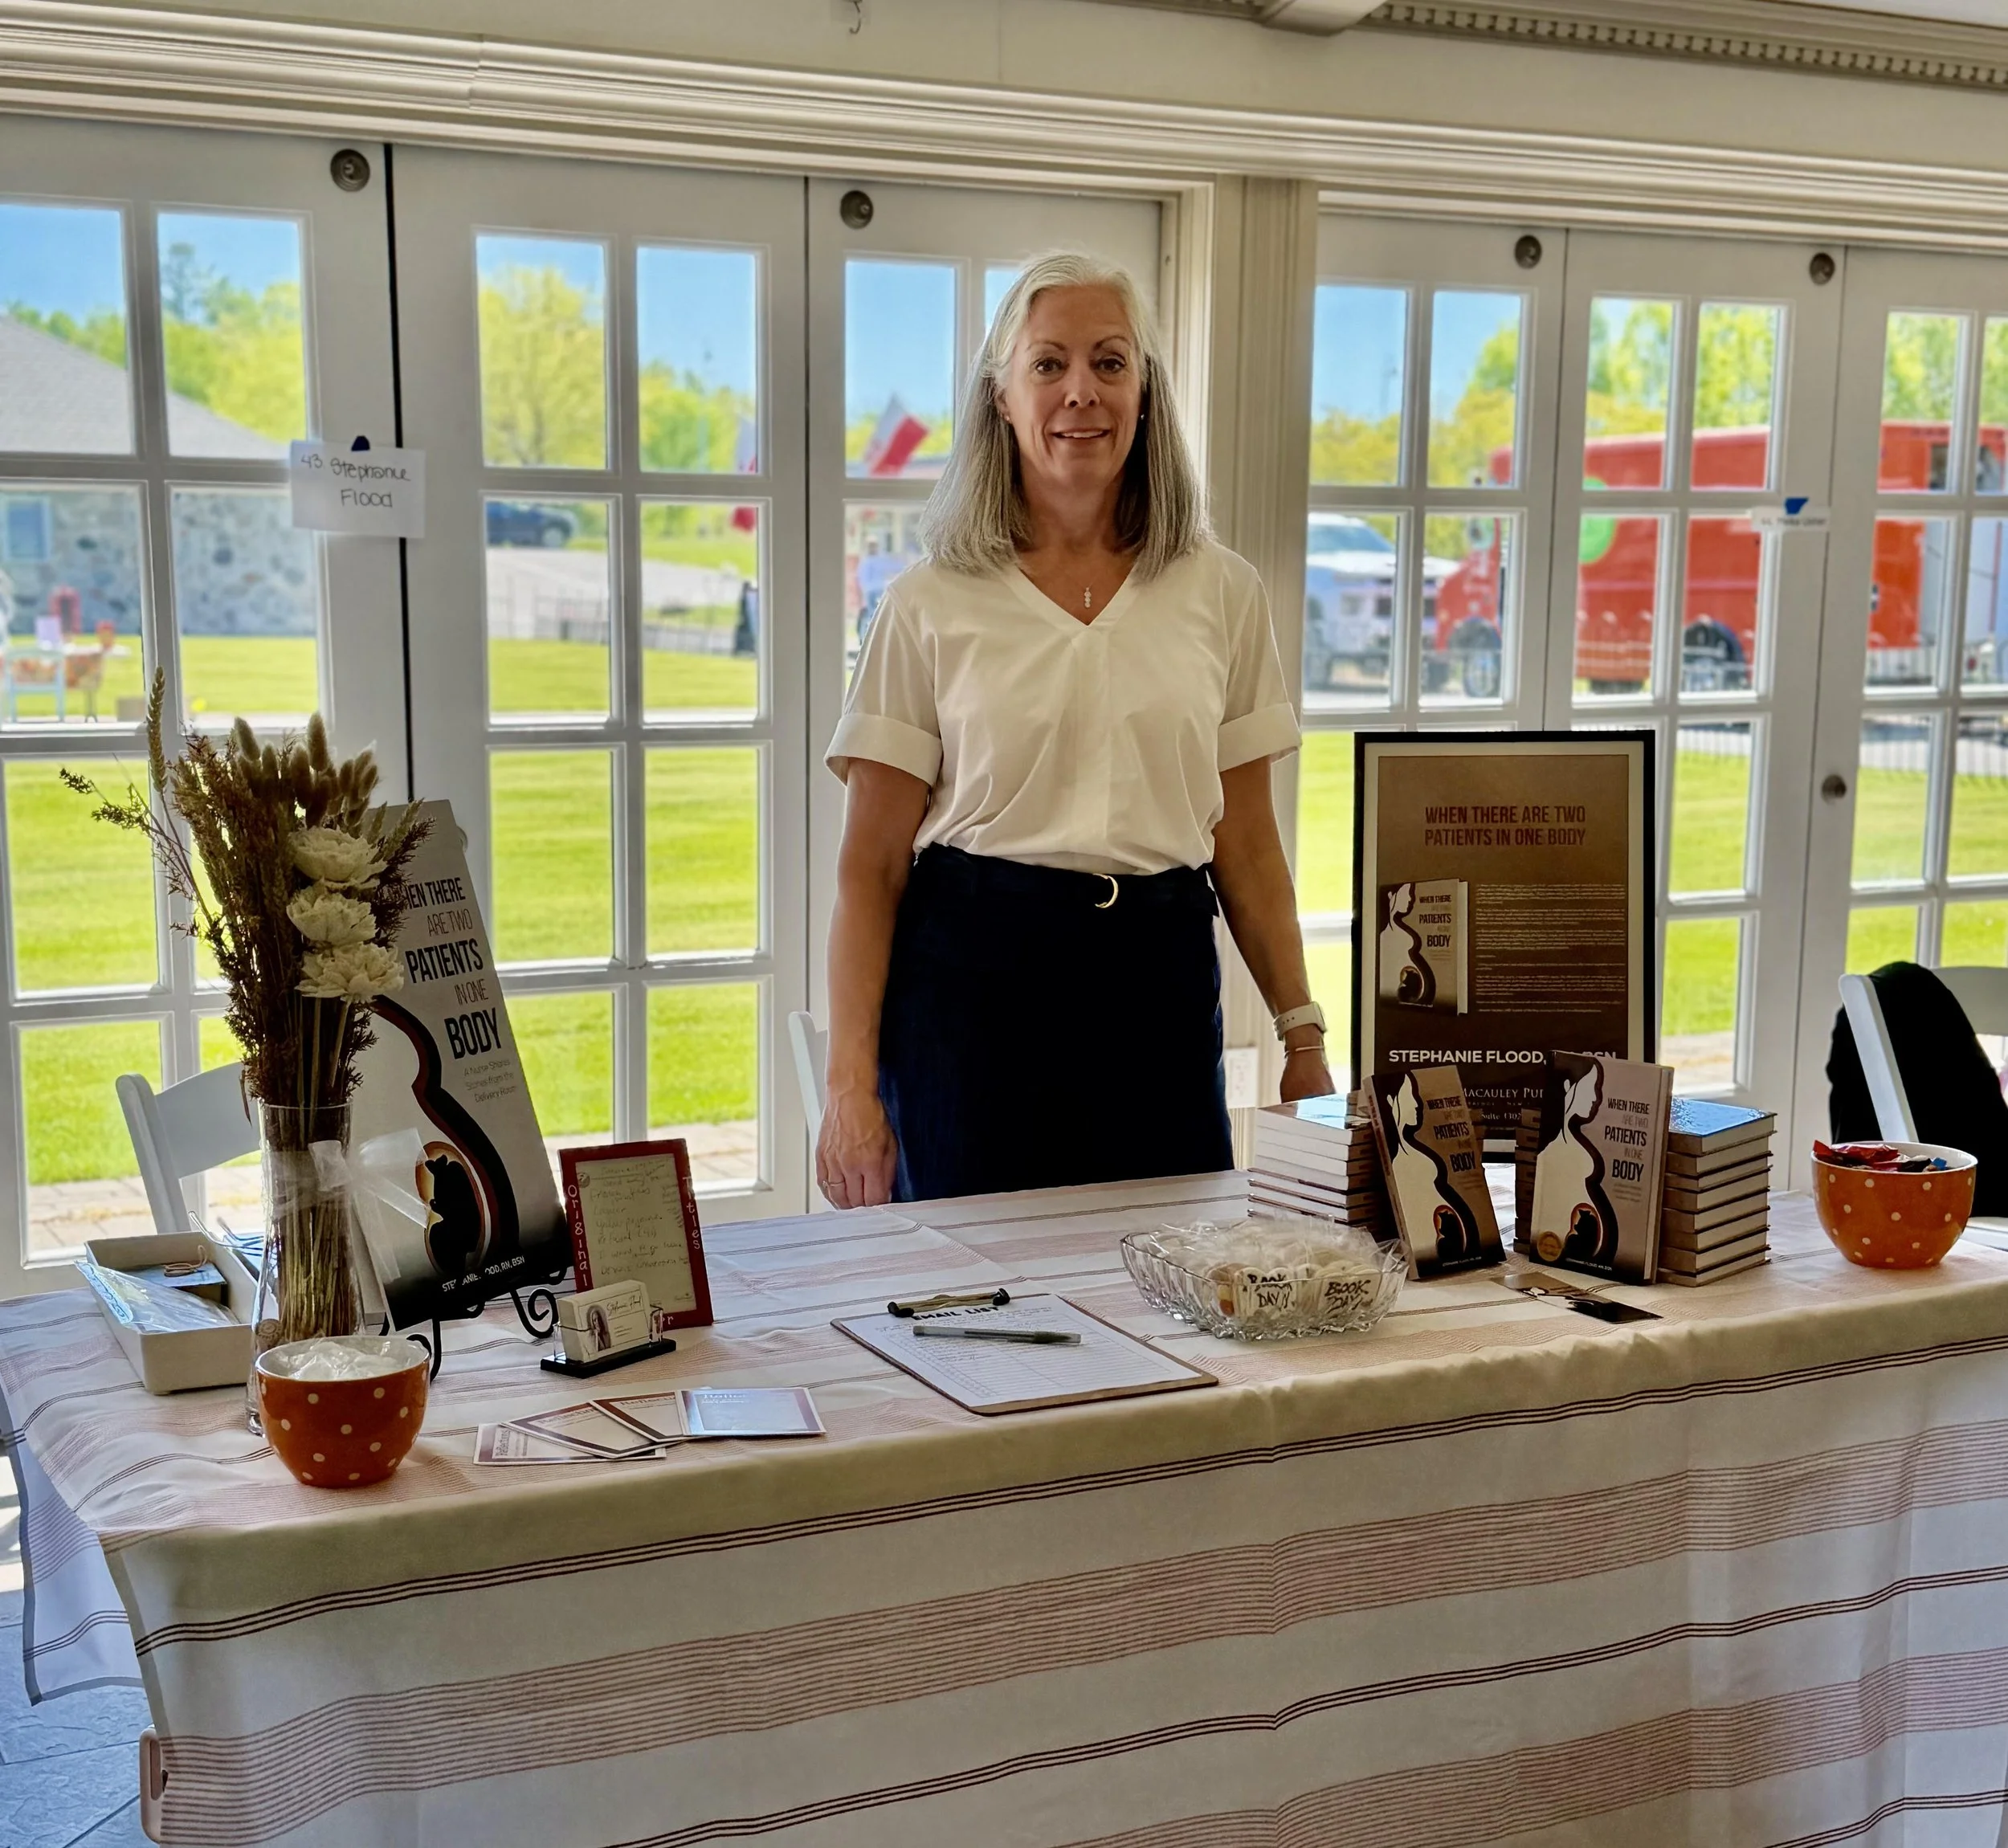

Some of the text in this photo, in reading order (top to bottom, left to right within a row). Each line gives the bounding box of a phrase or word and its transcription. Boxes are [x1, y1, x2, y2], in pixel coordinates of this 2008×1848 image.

[341, 488, 394, 508] Flood
[1425, 805, 1586, 824] WHEN THERE ARE TWO
[1425, 828, 1586, 846] PATIENTS IN ONE BODY
[424, 877, 466, 906] THERE
[426, 908, 473, 936] ARE TWO
[1418, 913, 1452, 924] PATIENTS
[1426, 935, 1452, 948] BODY
[405, 938, 484, 984] PATIENTS
[455, 979, 488, 1005] IN ONE
[444, 1007, 502, 1059] BODY
[1389, 1050, 1483, 1063] STEPHANIE
[1486, 1050, 1547, 1065] FLOOD,
[1426, 1098, 1443, 1111] WHEN
[1606, 1098, 1651, 1115] WHEN THERE
[1433, 1122, 1470, 1140] PATIENTS
[1604, 1125, 1647, 1147] PATIENTS
[1449, 1151, 1476, 1173] BODY
[1611, 1159, 1645, 1182] BODY
[683, 1176, 701, 1250] Titles
[568, 1185, 589, 1287] Original
[442, 1273, 479, 1291] STEANIE
[1325, 1279, 1371, 1296] BOOK
[912, 1307, 1001, 1320] EMAIL LIST
